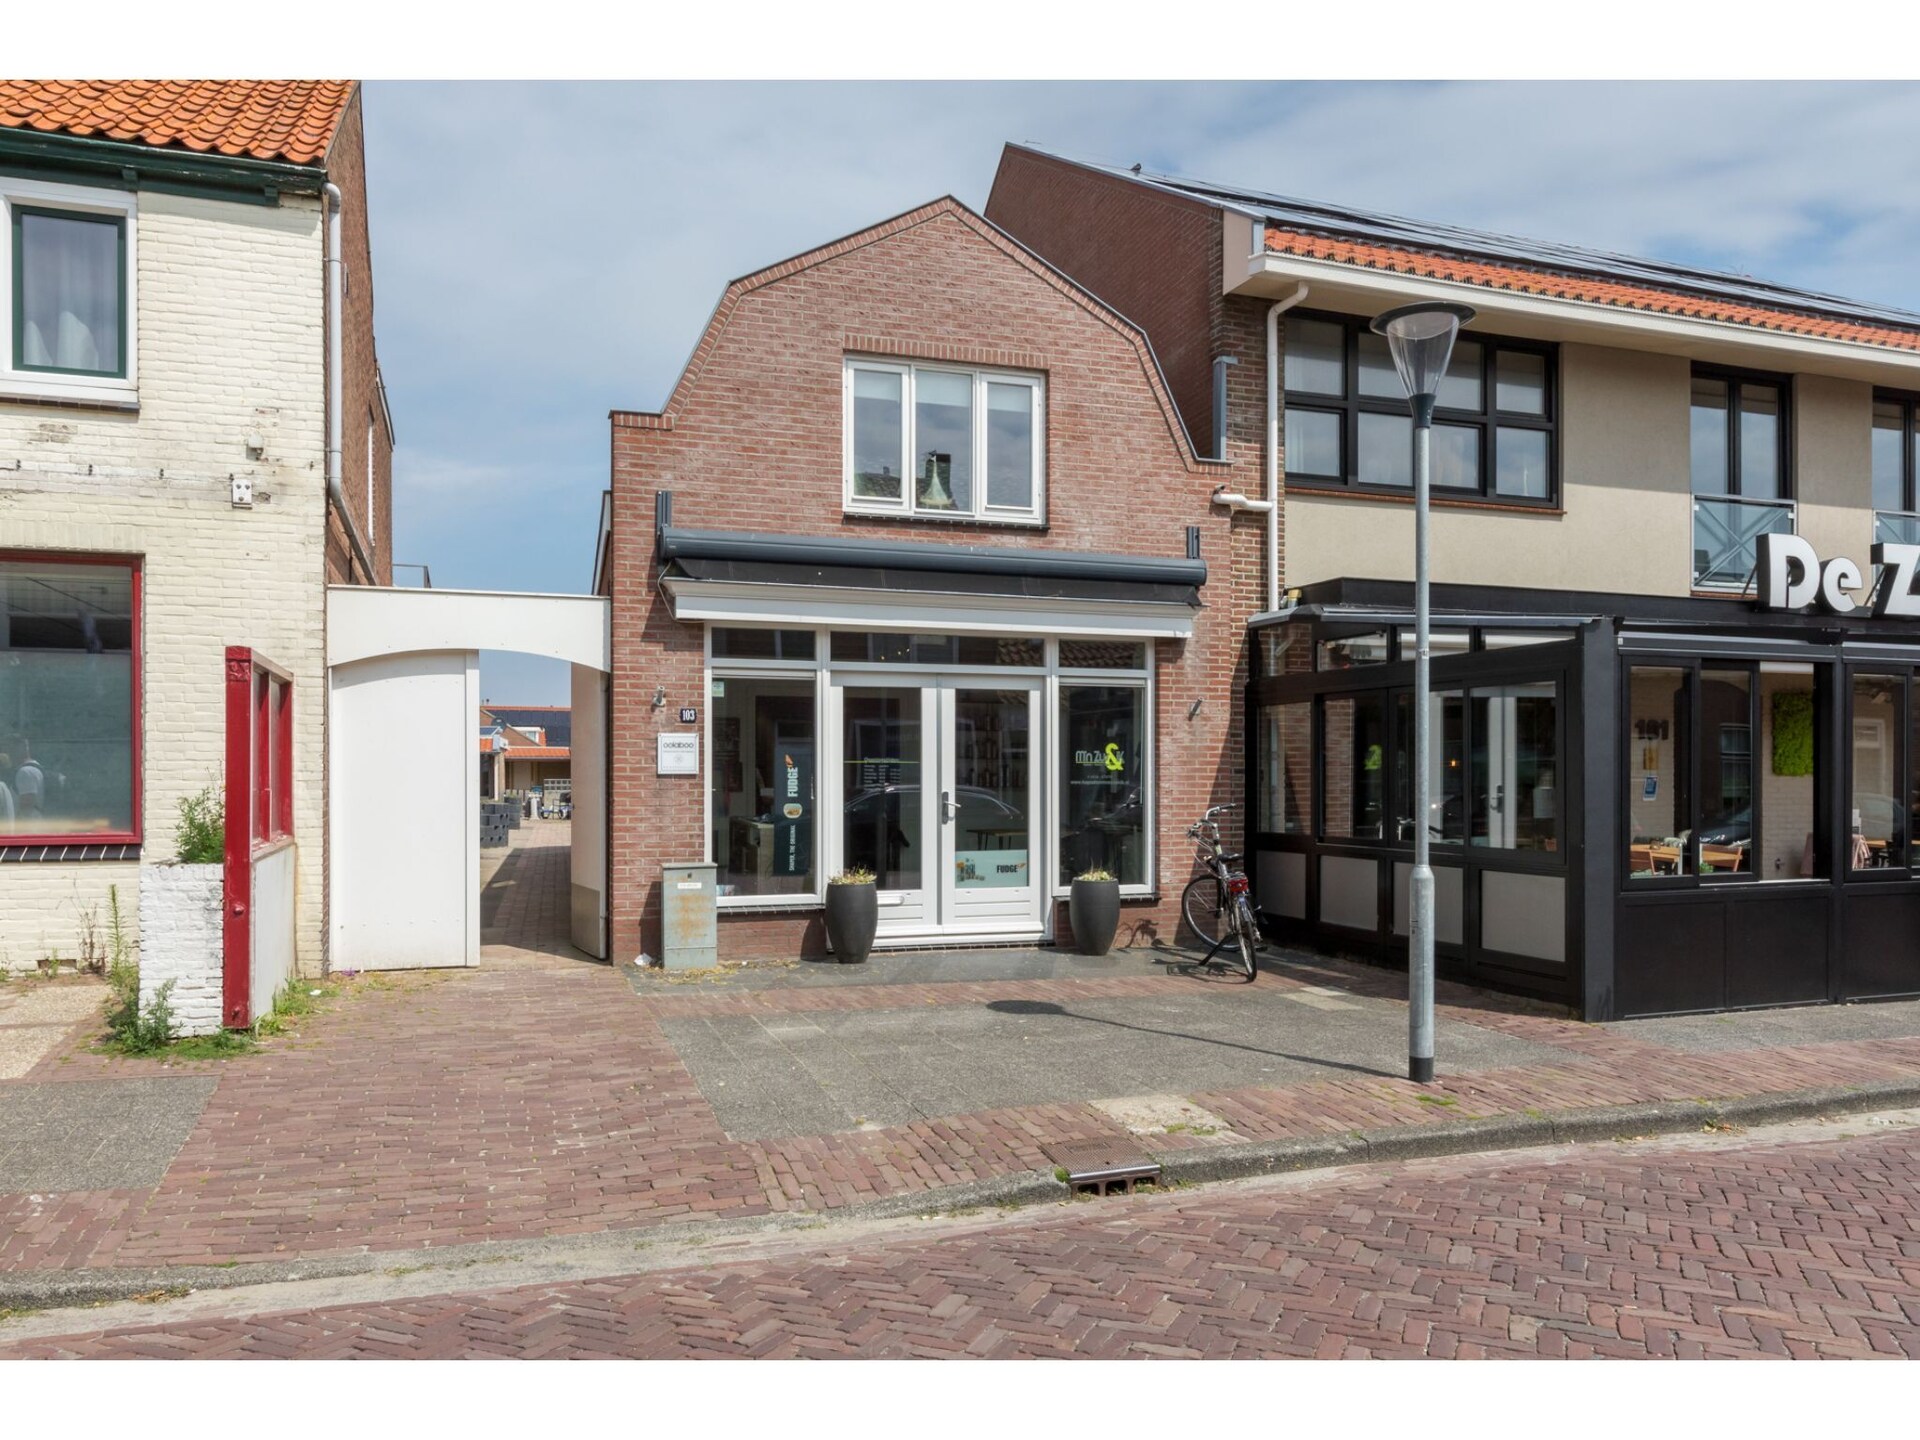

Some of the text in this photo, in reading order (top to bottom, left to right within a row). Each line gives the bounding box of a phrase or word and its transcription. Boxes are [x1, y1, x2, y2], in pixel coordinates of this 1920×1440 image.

[1756, 532, 1863, 612] De
[682, 709, 695, 721] 103
[787, 766, 799, 798] FUDGE
[996, 864, 1018, 873] FUDGE
